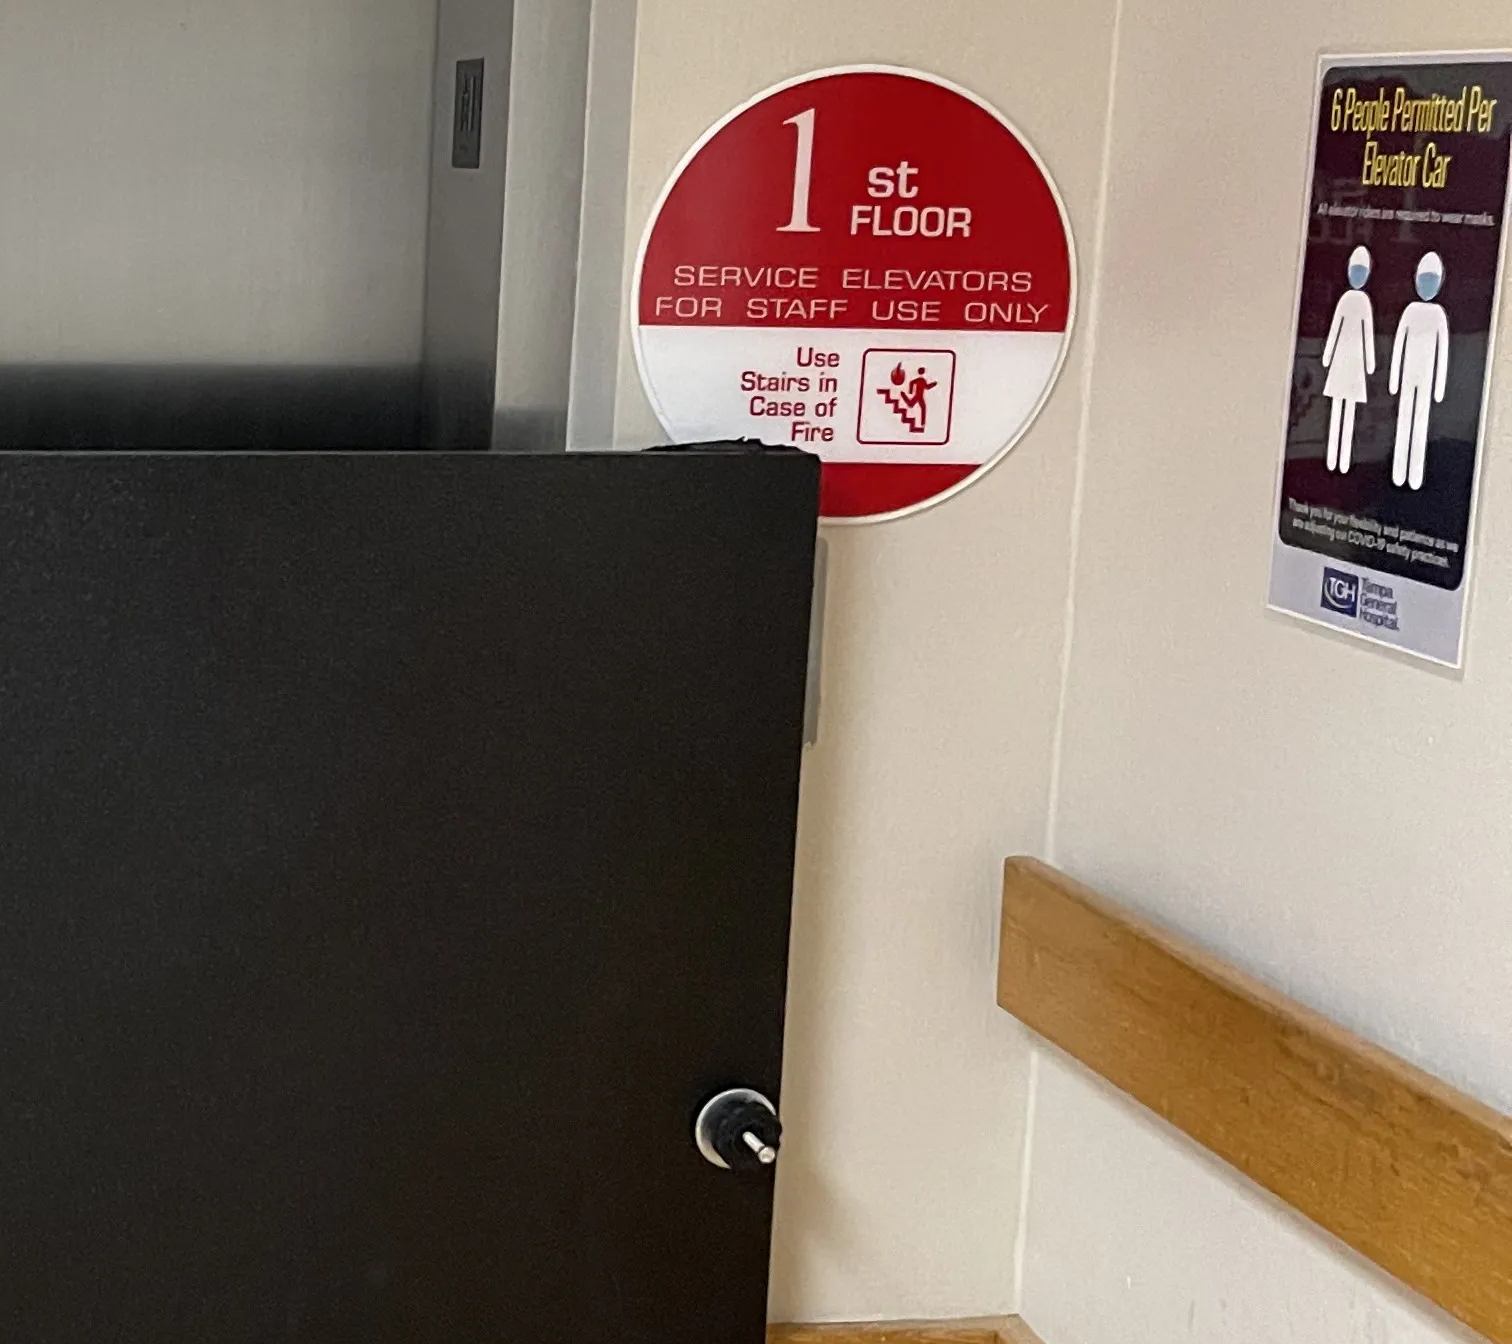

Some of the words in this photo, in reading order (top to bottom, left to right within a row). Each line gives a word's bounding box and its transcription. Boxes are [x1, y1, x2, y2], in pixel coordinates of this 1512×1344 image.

[1330, 88, 1343, 132] 6
[1343, 87, 1390, 140] People
[1391, 86, 1468, 133] Permitted
[1466, 85, 1498, 133] Per
[776, 108, 821, 232] 1
[867, 161, 919, 199] st
[1362, 141, 1422, 187] Elevator
[1422, 142, 1453, 188] Car
[850, 205, 972, 238] FLOOR
[674, 266, 819, 289] SERVICE
[842, 269, 1033, 292] ELEVATORS
[655, 296, 722, 318] FOR
[746, 299, 849, 320] STAFF
[872, 300, 942, 322] USE
[964, 302, 1049, 324] ONLY
[796, 347, 841, 367] Use
[740, 370, 811, 392] Stairs
[819, 371, 838, 393] in
[749, 395, 806, 417] Case
[814, 397, 838, 417] of
[791, 421, 834, 442] Fire
[1329, 577, 1356, 603] TGH
